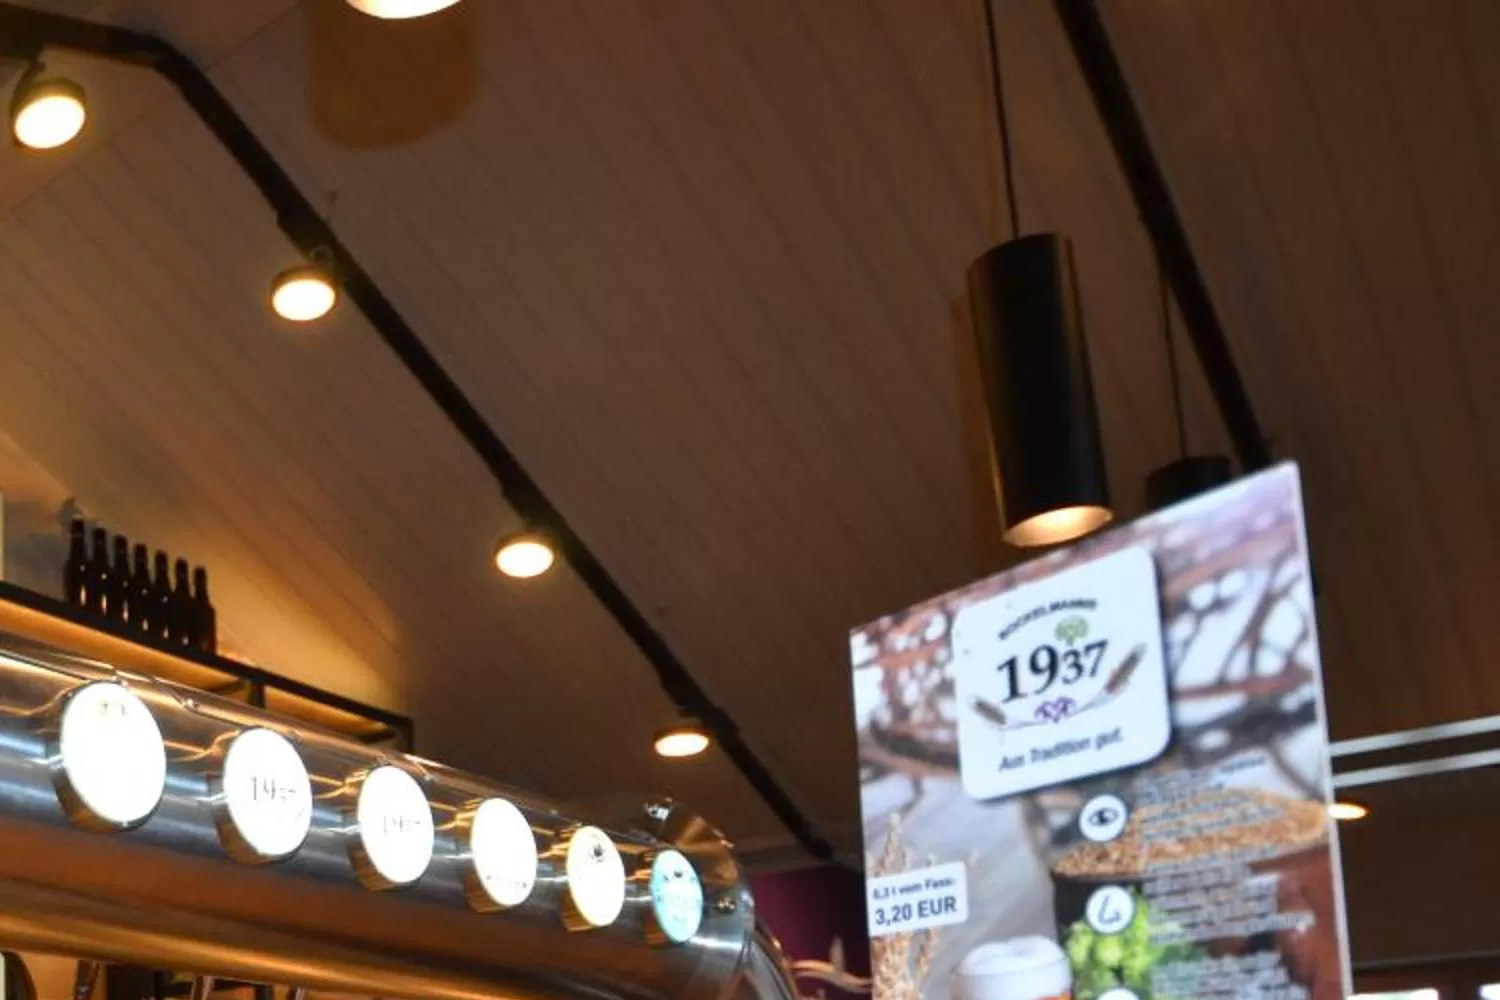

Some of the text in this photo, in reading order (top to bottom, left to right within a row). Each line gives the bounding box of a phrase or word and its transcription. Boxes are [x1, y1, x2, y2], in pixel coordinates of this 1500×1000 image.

[996, 639, 1109, 704] 1937
[998, 755, 1026, 772] Aus
[1030, 738, 1092, 764] Tradition
[875, 895, 958, 927] 3,20 EUR
